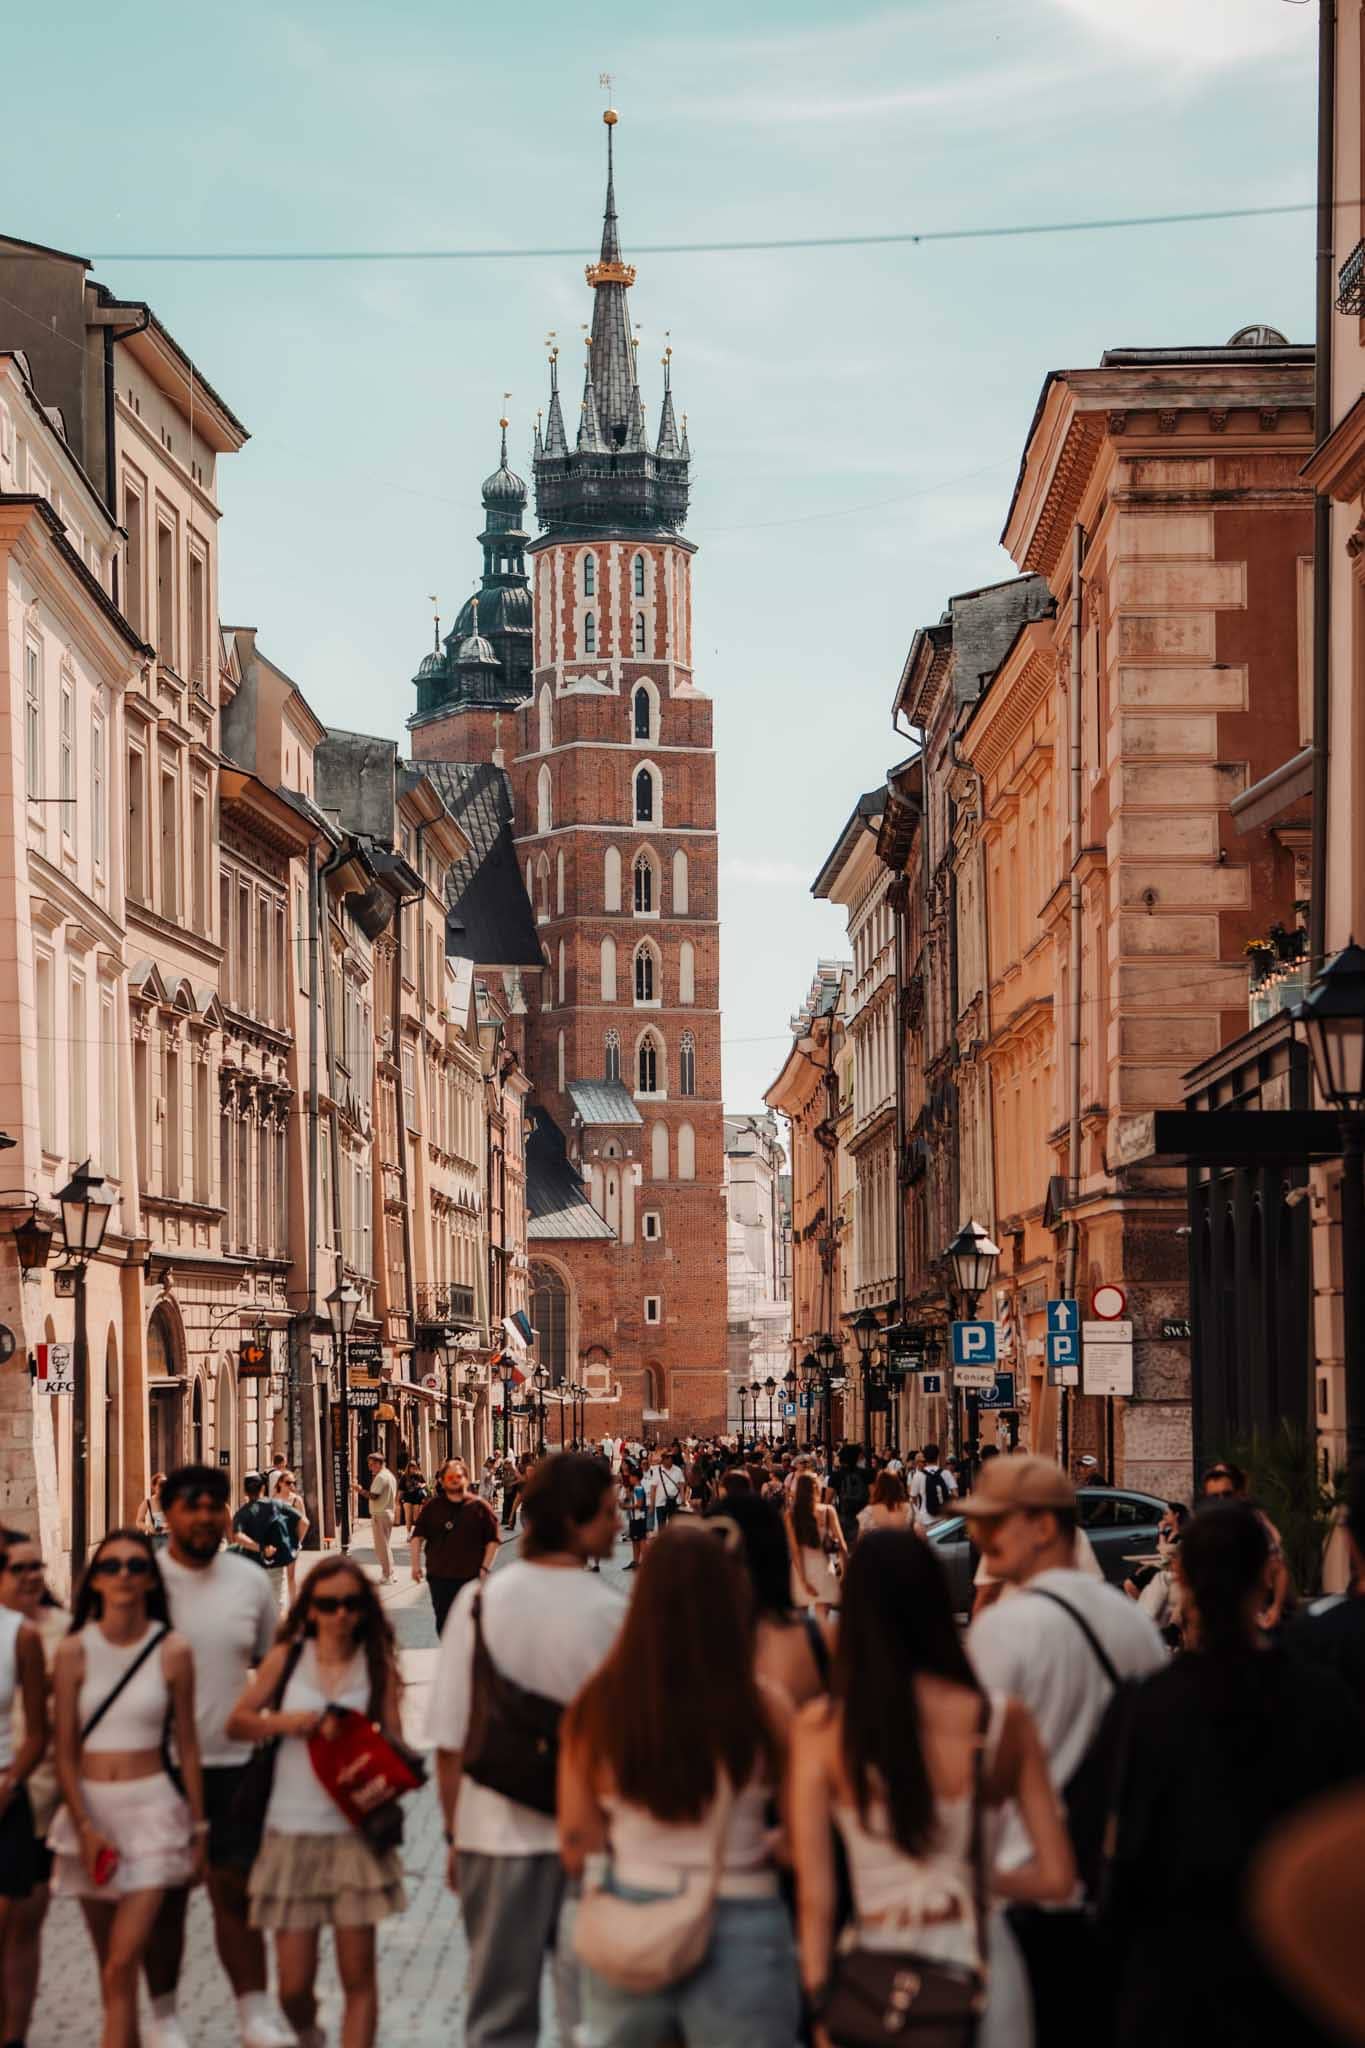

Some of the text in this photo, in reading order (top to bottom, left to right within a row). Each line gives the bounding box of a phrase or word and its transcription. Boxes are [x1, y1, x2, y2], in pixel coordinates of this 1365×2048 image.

[962, 1326, 986, 1360] P
[1053, 1336, 1072, 1362] P
[45, 1381, 75, 1392] KFC
[957, 1373, 992, 1382] Koniec
